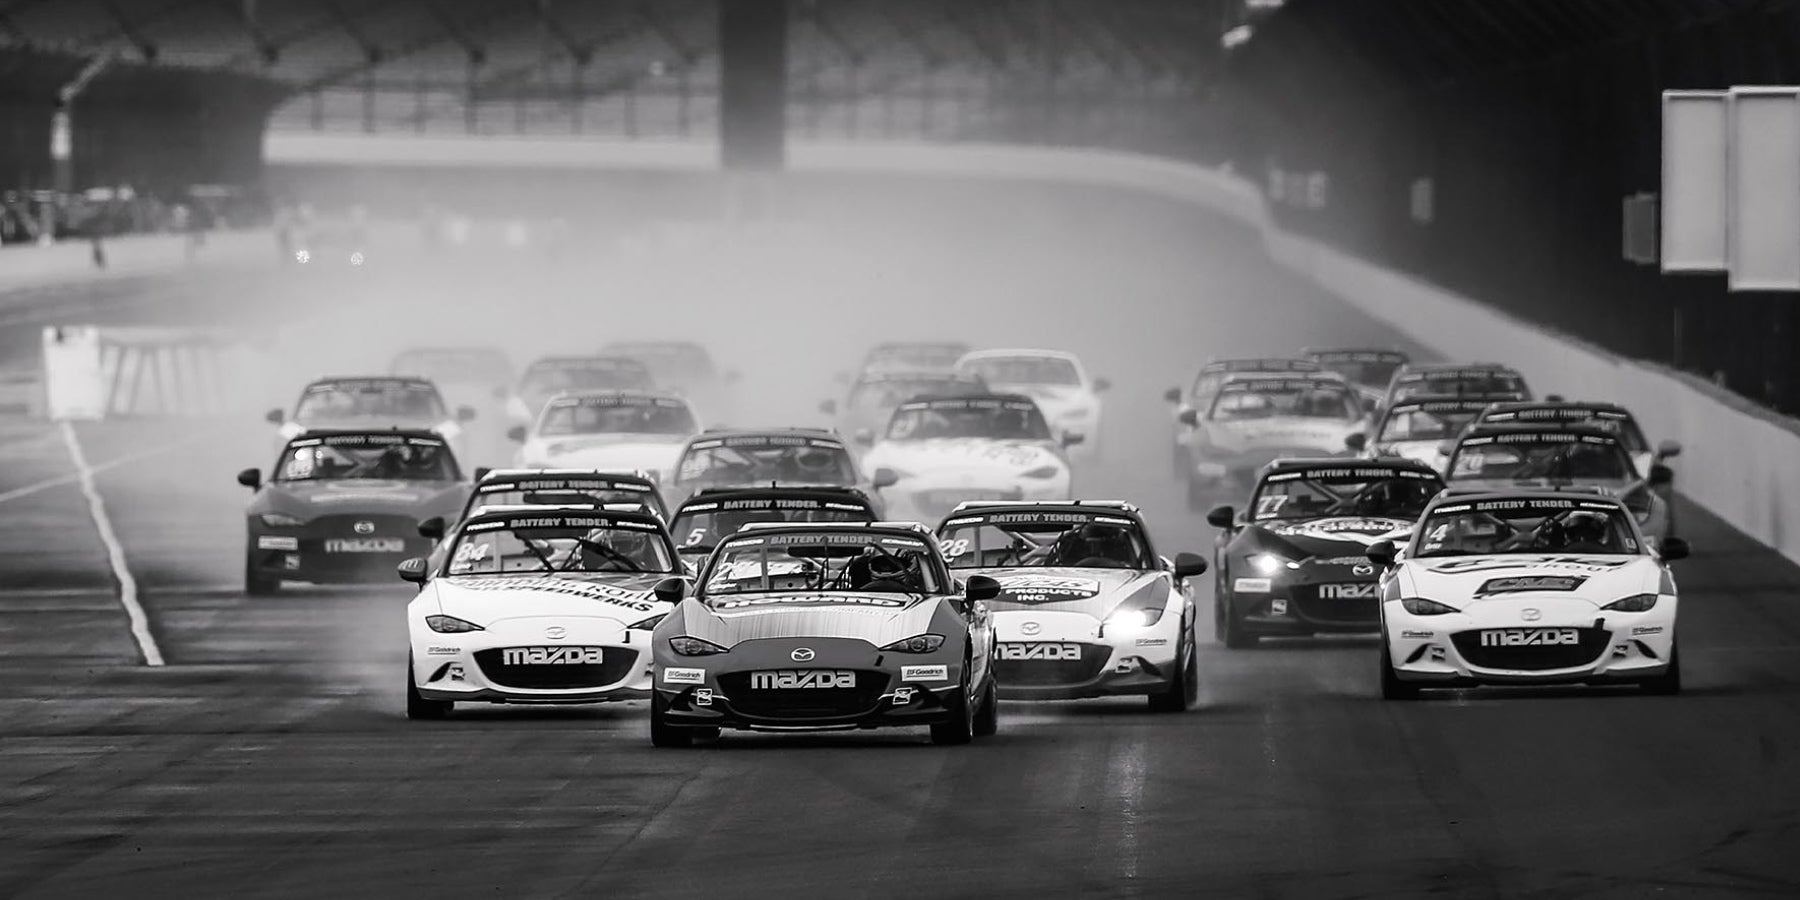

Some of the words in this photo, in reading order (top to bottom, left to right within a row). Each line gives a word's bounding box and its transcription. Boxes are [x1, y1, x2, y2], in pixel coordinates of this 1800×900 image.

[1307, 470, 1350, 479] BATTERY
[724, 500, 772, 509] BATTERY
[1256, 495, 1288, 513] 77
[1476, 501, 1526, 511] BATTERY
[510, 518, 561, 528] BATTERY
[989, 513, 1040, 523] BATTERY
[685, 527, 706, 546] 5
[770, 535, 826, 545] BATTERY
[1429, 523, 1449, 542] 4
[455, 542, 489, 562] 84
[940, 538, 969, 557] 28
[1005, 588, 1093, 598] PRODUCTS
[724, 596, 901, 610] HOWARD
[1480, 628, 1579, 647] mazda
[503, 647, 603, 665] mazda
[751, 670, 856, 689] mazda
